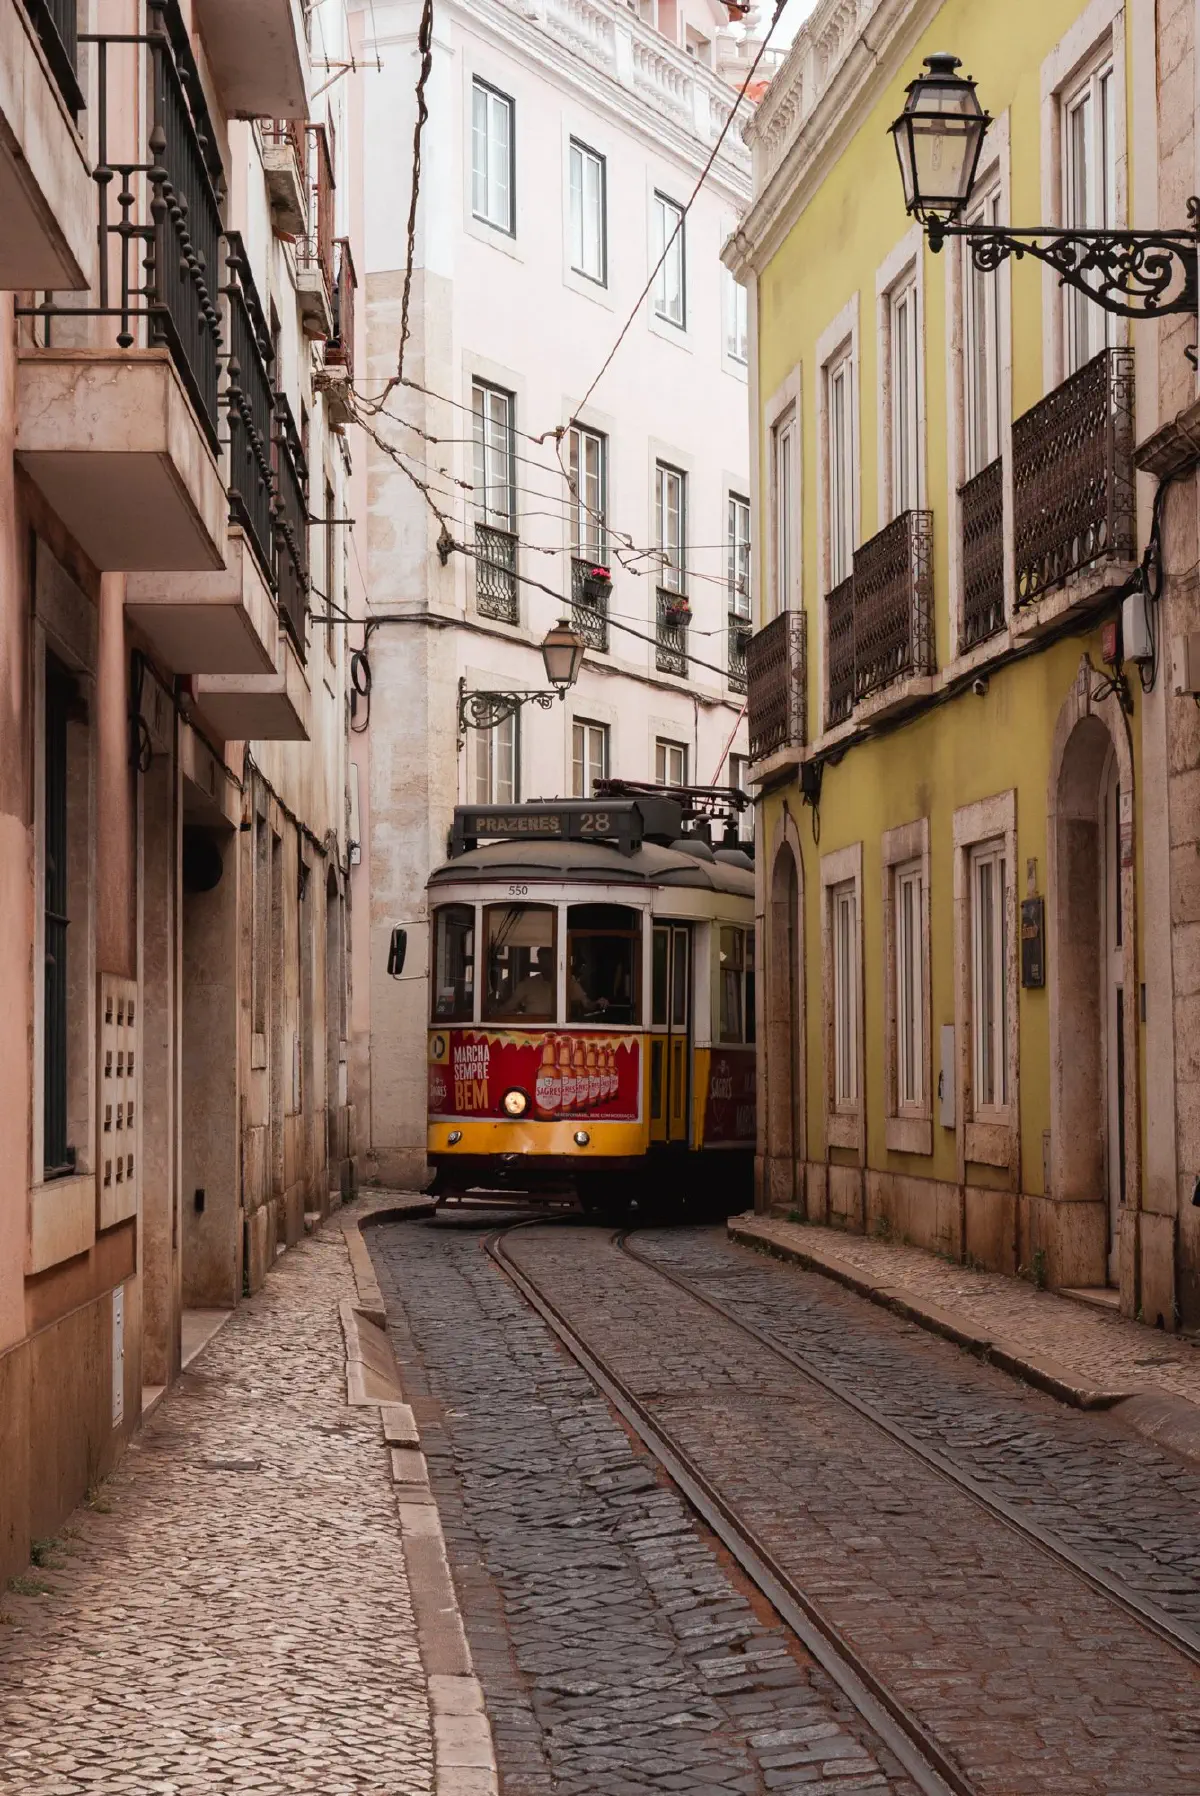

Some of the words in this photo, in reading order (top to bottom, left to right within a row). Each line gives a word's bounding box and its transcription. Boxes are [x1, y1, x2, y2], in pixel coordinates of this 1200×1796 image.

[476, 815, 560, 833] PRAZERES
[579, 813, 611, 833] 28
[508, 885, 529, 896] 550
[453, 1044, 491, 1063] MARCHA
[454, 1062, 490, 1081] SEMPRE
[454, 1080, 489, 1111] BEM
[536, 1086, 562, 1097] SAGRES
